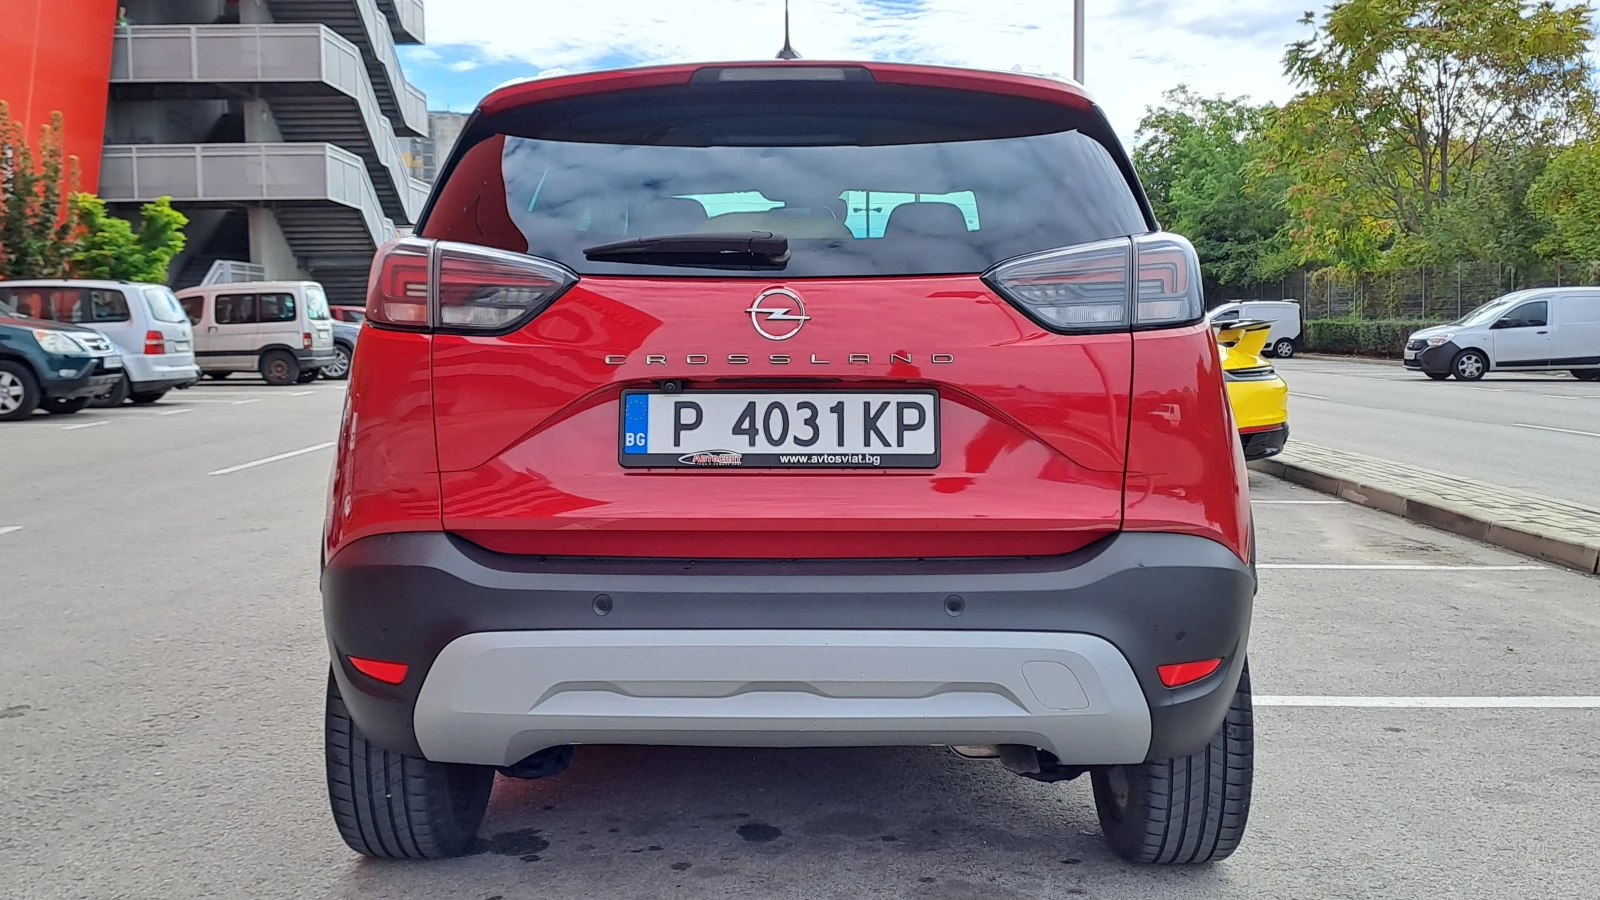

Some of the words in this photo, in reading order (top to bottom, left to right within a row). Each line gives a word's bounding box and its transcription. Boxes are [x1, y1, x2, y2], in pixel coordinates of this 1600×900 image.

[605, 353, 955, 366] CROSSLAND
[673, 401, 704, 447] P
[732, 401, 846, 447] 4031
[863, 401, 927, 447] KP
[625, 432, 646, 447] BG
[779, 454, 881, 466] www.avtosviat.bg
